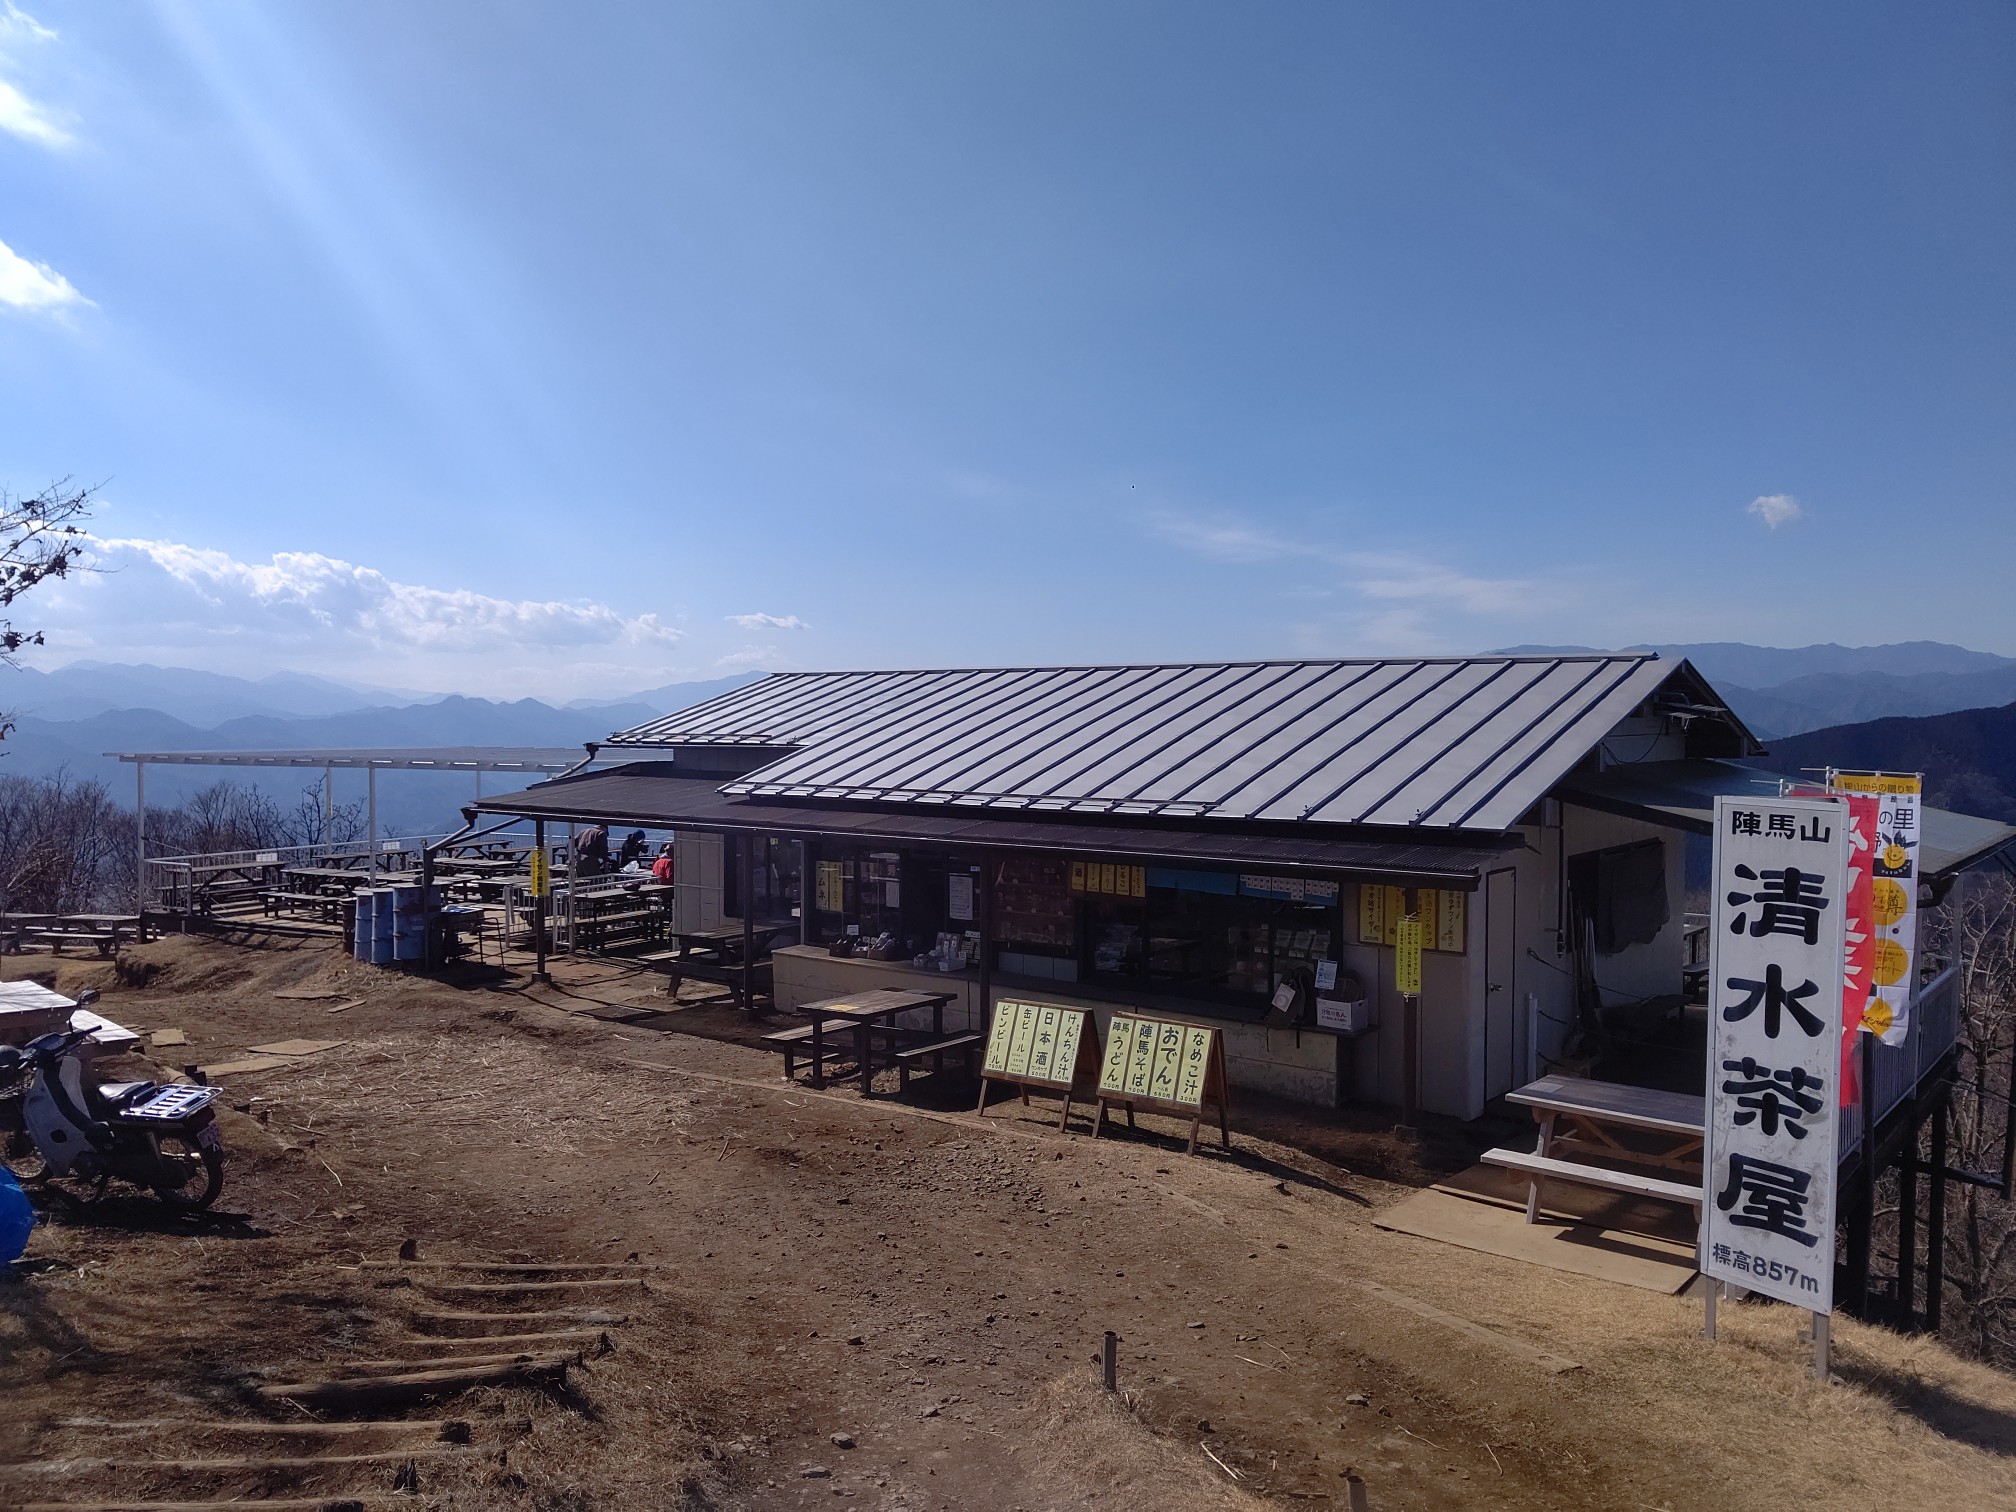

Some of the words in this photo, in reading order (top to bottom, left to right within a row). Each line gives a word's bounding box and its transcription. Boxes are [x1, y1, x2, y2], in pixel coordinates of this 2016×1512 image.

[1732, 811, 1831, 843] 陣馬山
[991, 1005, 1010, 1064] ビンビール
[1016, 1007, 1033, 1053] 缶ビール
[1035, 1011, 1054, 1066] 日本酒
[1057, 1013, 1077, 1076] けんちん汁
[1112, 1021, 1130, 1033] 陣馬
[1106, 1036, 1123, 1082] うどん
[1131, 1024, 1153, 1087] 陣馬そば
[1155, 1027, 1180, 1085] おでん
[1183, 1032, 1205, 1095] なめこ汁
[1717, 863, 1830, 1248] 清水茶屋
[1713, 1243, 1819, 1294] 標高857m
